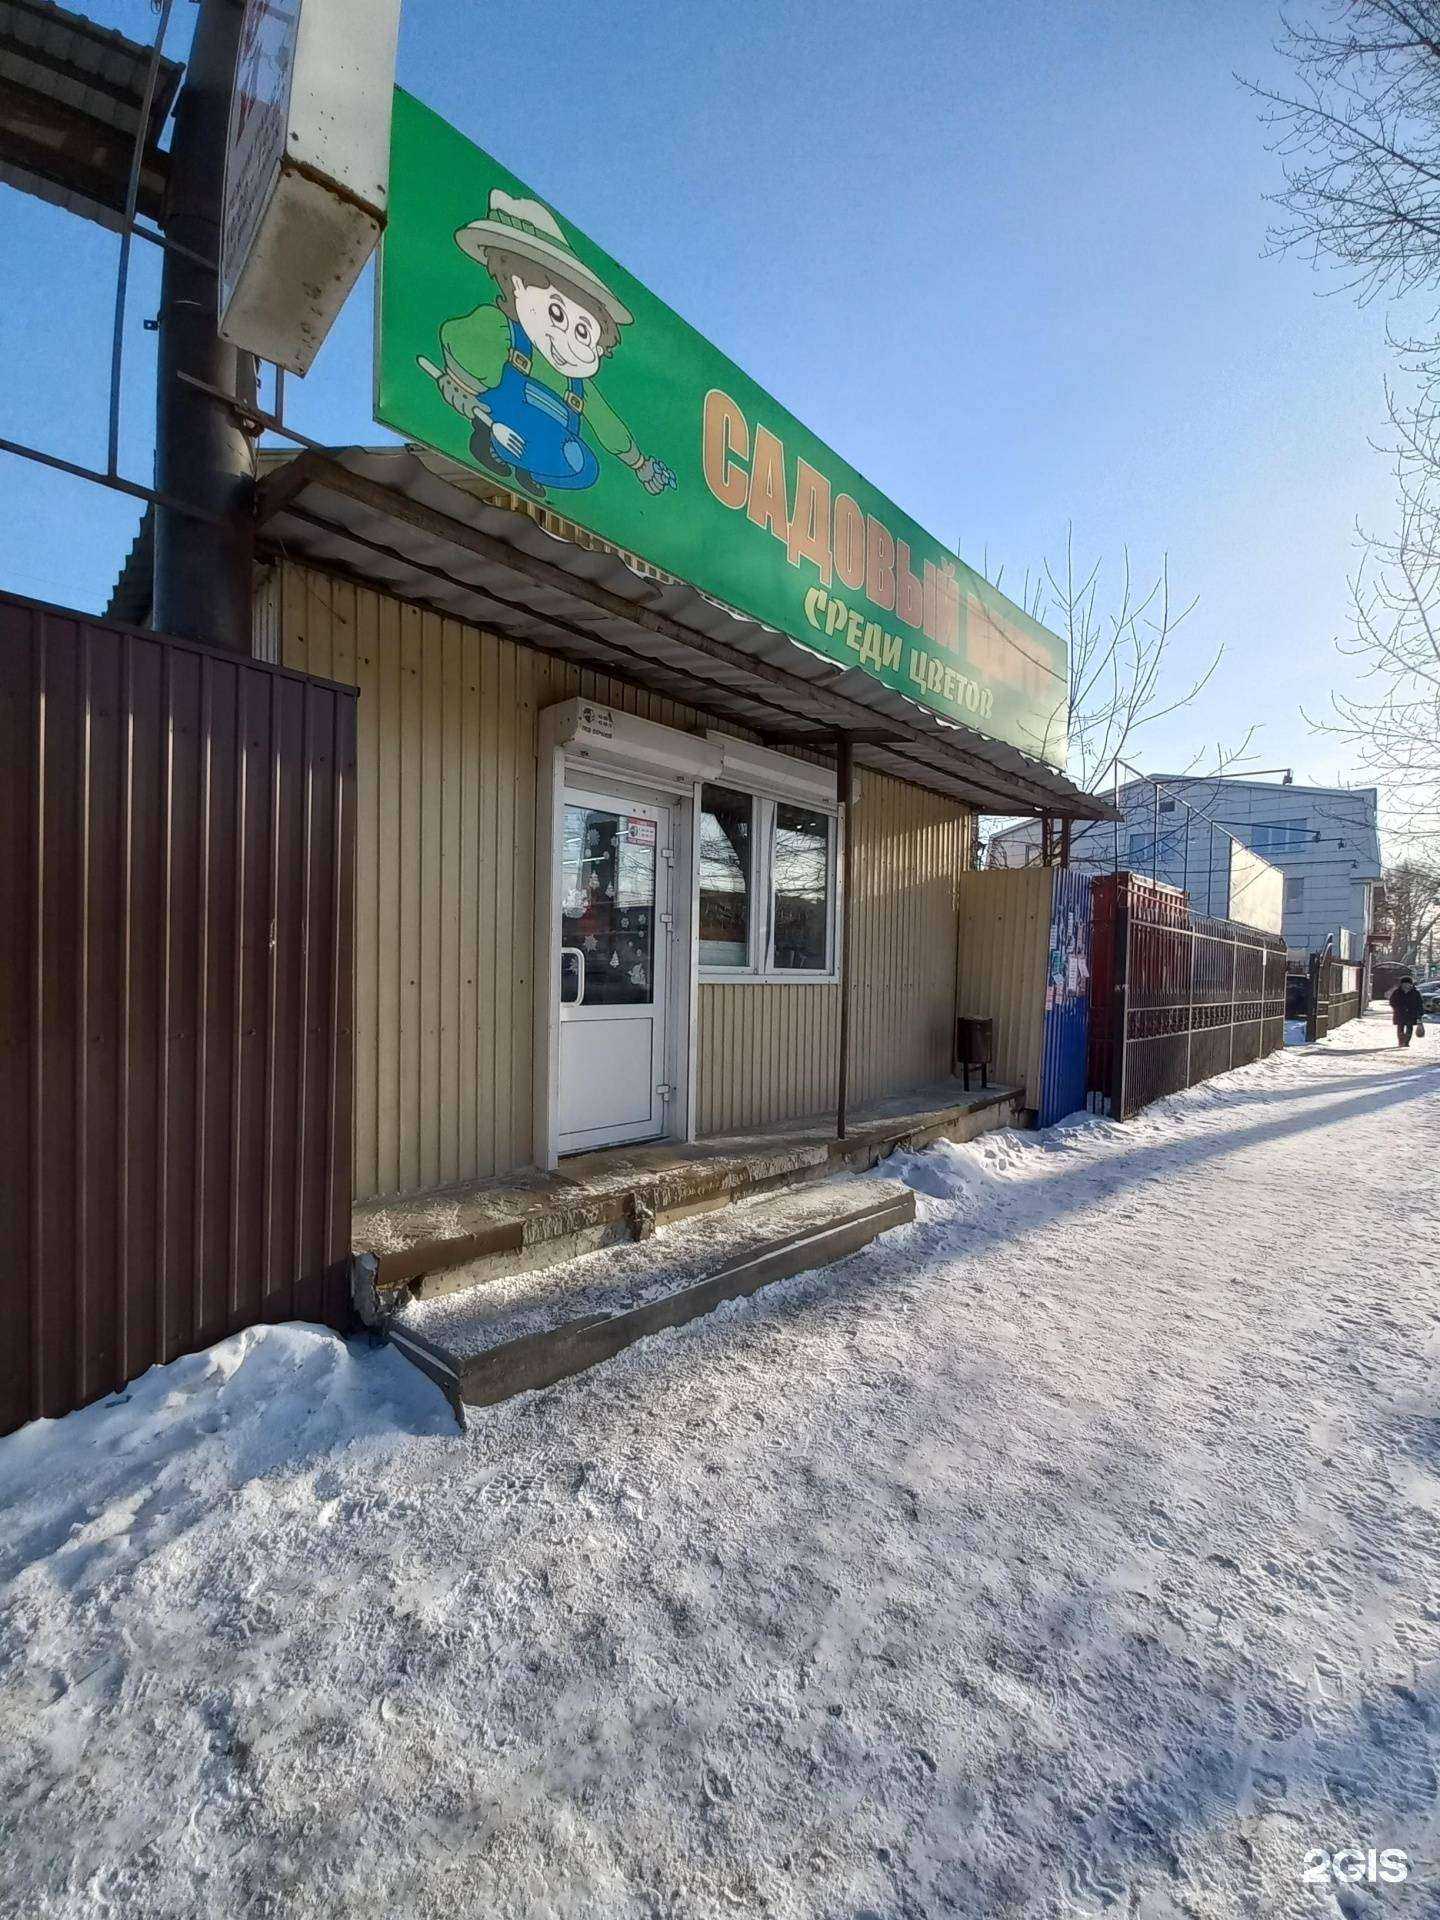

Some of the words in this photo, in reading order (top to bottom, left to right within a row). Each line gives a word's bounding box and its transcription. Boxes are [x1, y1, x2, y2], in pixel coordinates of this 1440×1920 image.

[703, 388, 959, 654] САДОВЫЙ
[804, 587, 904, 672] СРЕДИ
[910, 648, 993, 720] ЦВЕТОВ
